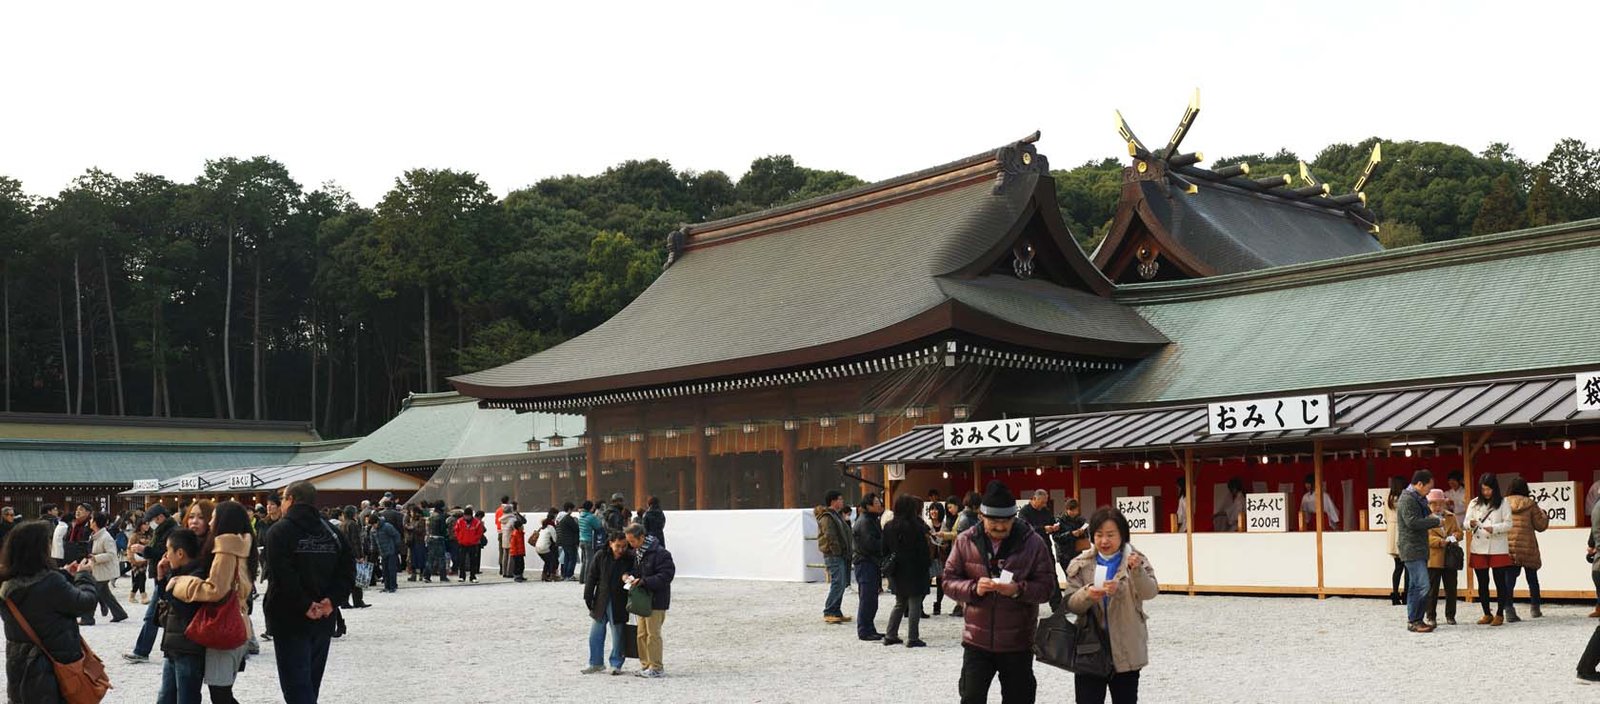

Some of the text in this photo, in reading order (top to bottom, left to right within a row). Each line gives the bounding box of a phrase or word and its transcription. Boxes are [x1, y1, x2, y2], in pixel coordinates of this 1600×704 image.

[1216, 399, 1319, 432] おみくじ
[950, 421, 1022, 447] おみくじ
[1118, 500, 1150, 514] おみくじ
[1247, 497, 1284, 512] おみくじ
[1127, 518, 1147, 529] 00円
[1250, 516, 1280, 528] 200円
